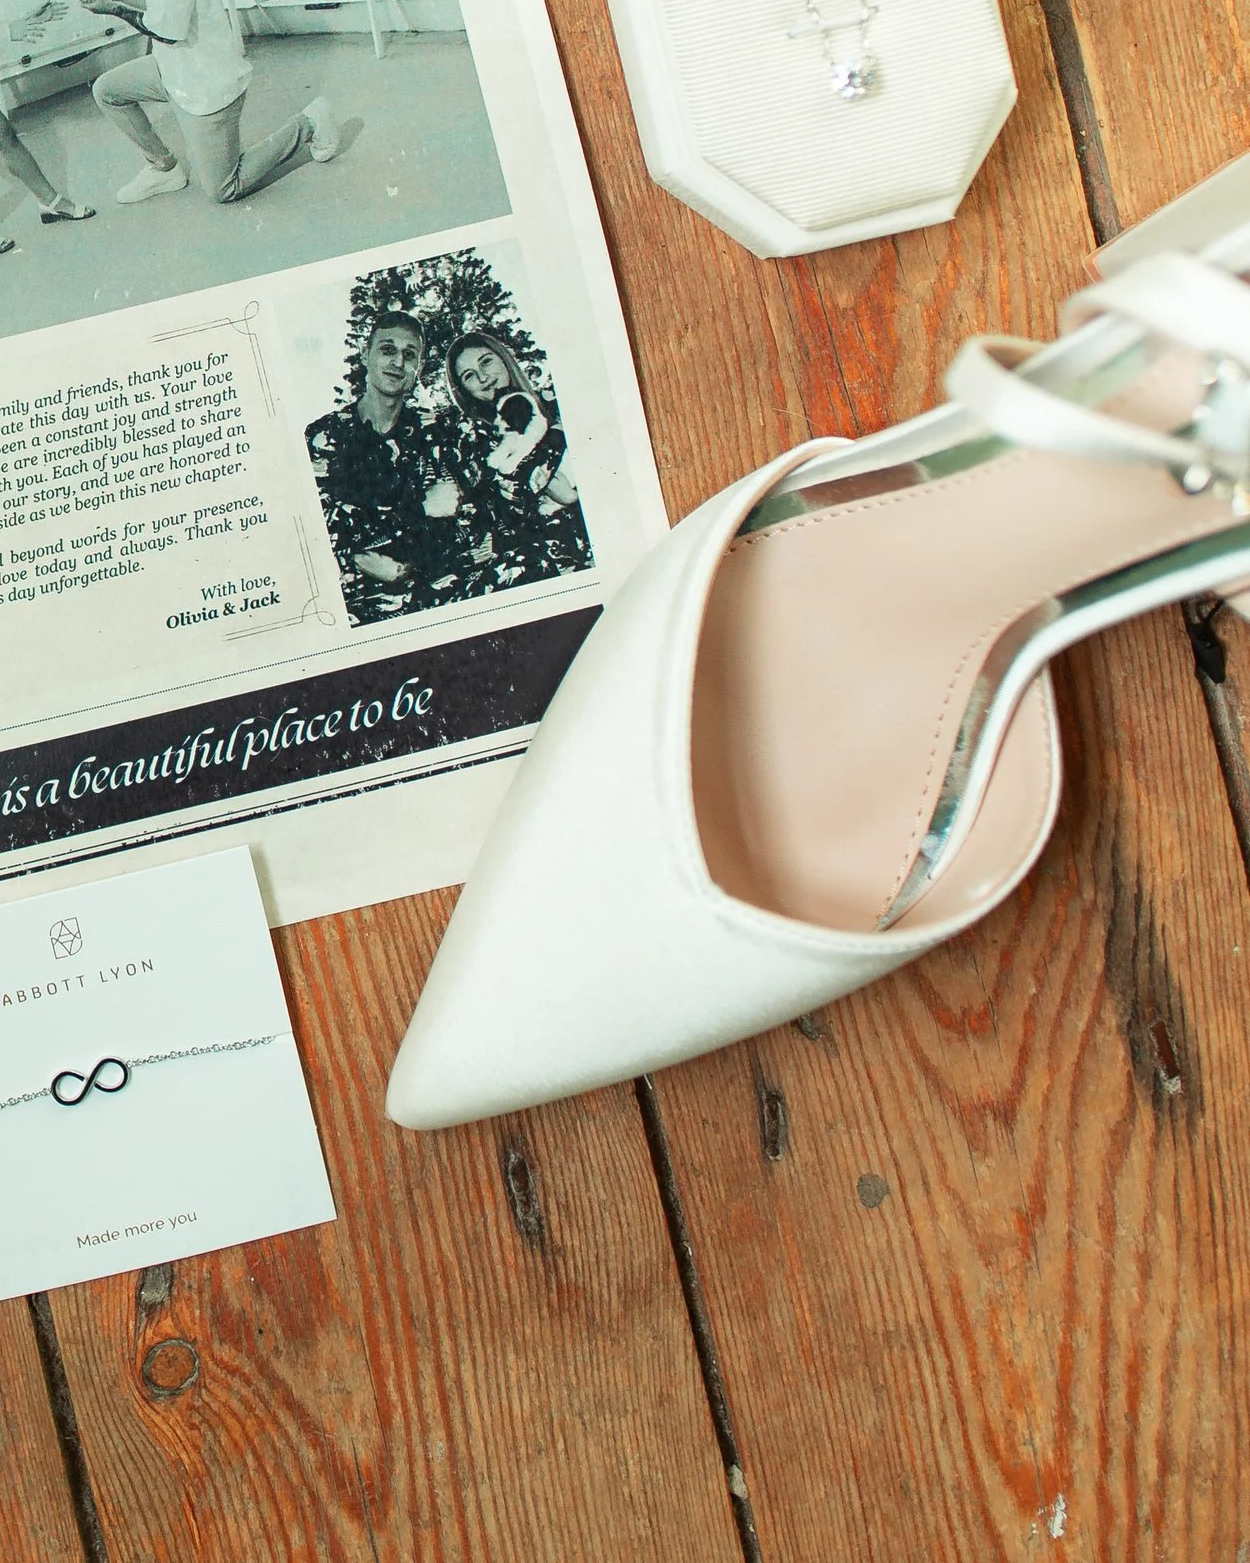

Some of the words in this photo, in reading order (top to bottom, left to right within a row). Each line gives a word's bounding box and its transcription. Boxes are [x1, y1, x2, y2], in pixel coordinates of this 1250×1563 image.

[29, 411, 56, 429] this
[61, 405, 89, 422] day
[95, 393, 130, 413] with
[133, 390, 155, 404] us.
[160, 379, 197, 398] Your
[202, 371, 233, 387] love
[34, 389, 63, 409] and
[64, 377, 124, 406] friends,
[127, 364, 171, 387] thank
[174, 360, 203, 379] you
[204, 352, 229, 372] for
[13, 455, 39, 470] are
[42, 434, 117, 463] incredibly
[122, 418, 176, 444] blessed
[181, 417, 196, 431] to
[200, 407, 242, 426] share
[29, 509, 46, 522] as
[48, 503, 71, 517] we
[74, 490, 116, 511] begin
[118, 482, 147, 501] this
[149, 477, 181, 494] new
[185, 462, 247, 485] chapter.
[10, 538, 65, 564] beyond
[70, 527, 117, 550] words
[121, 522, 146, 542] for
[151, 512, 187, 534] your
[193, 496, 264, 525] presence,
[34, 558, 77, 577] today
[84, 545, 114, 566] and
[119, 534, 178, 557] always.
[184, 517, 234, 541] Thank
[239, 513, 268, 532] you
[7, 586, 36, 602] day
[39, 559, 145, 595] unforgettable.
[200, 581, 238, 601] With
[240, 575, 276, 592] love,
[166, 607, 220, 629] Olivia
[222, 601, 236, 617] &
[239, 590, 281, 613] Jack
[1, 776, 31, 816] is
[35, 779, 61, 808] a
[68, 720, 245, 800] beautiful
[240, 707, 343, 771] place
[349, 699, 383, 732] to
[391, 676, 433, 721] be
[2, 974, 85, 1007] ABBOTT
[99, 958, 154, 983] LYON
[76, 1229, 120, 1249] Made
[124, 1219, 165, 1238] more
[168, 1211, 198, 1231] you
